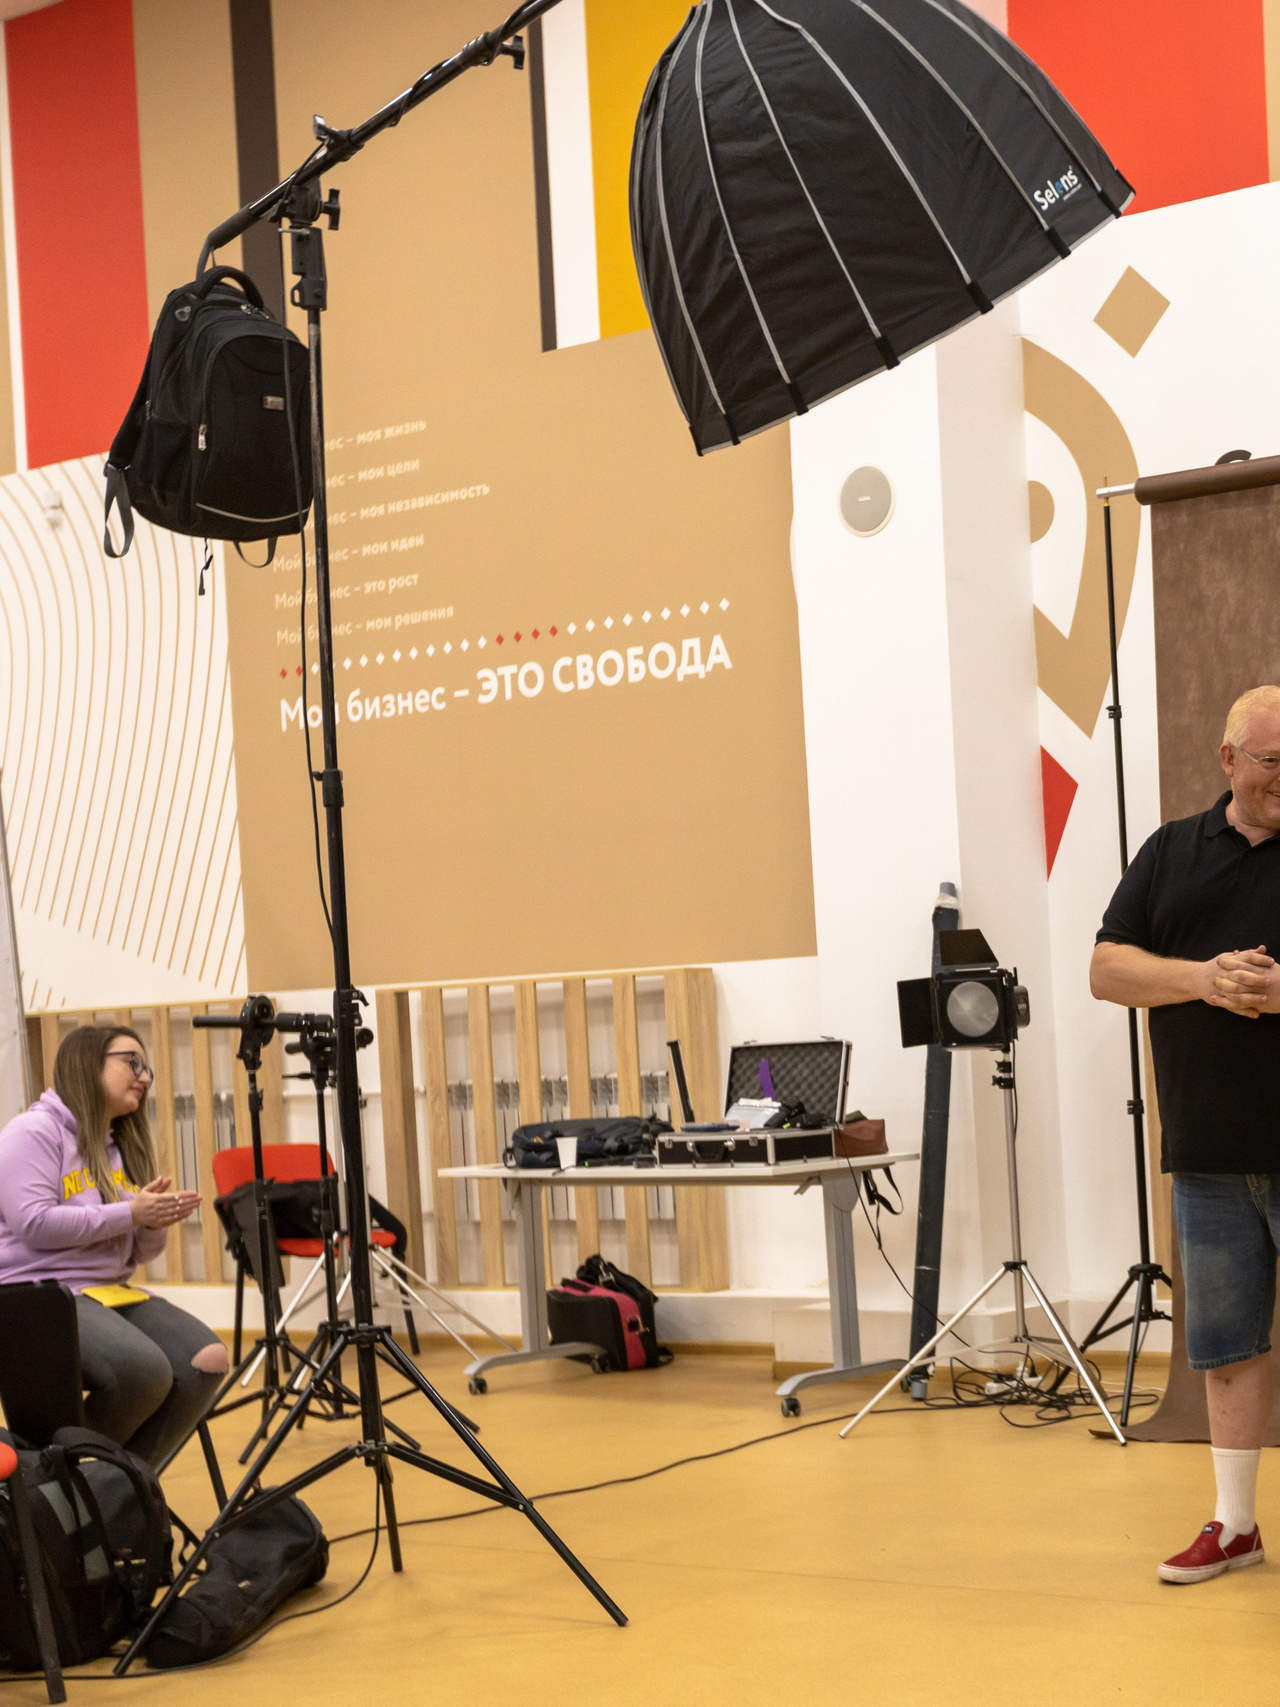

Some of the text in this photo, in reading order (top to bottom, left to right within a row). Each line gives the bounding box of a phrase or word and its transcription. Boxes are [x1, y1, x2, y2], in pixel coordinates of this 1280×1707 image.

[1033, 169, 1079, 211] Selens
[356, 429, 382, 445] моя
[383, 420, 427, 439] жизнь
[358, 465, 384, 482] мои
[387, 459, 420, 477] цели
[360, 503, 385, 520] моя
[387, 483, 490, 514] независимость
[362, 541, 388, 557] мои
[390, 534, 424, 552] идеи
[363, 580, 386, 595] это
[388, 573, 419, 594] рост
[365, 615, 392, 632] мои
[394, 605, 454, 631] решения
[346, 686, 447, 723] бизнес
[476, 661, 545, 704] ЭТО
[552, 633, 733, 693] СВОБОДА
